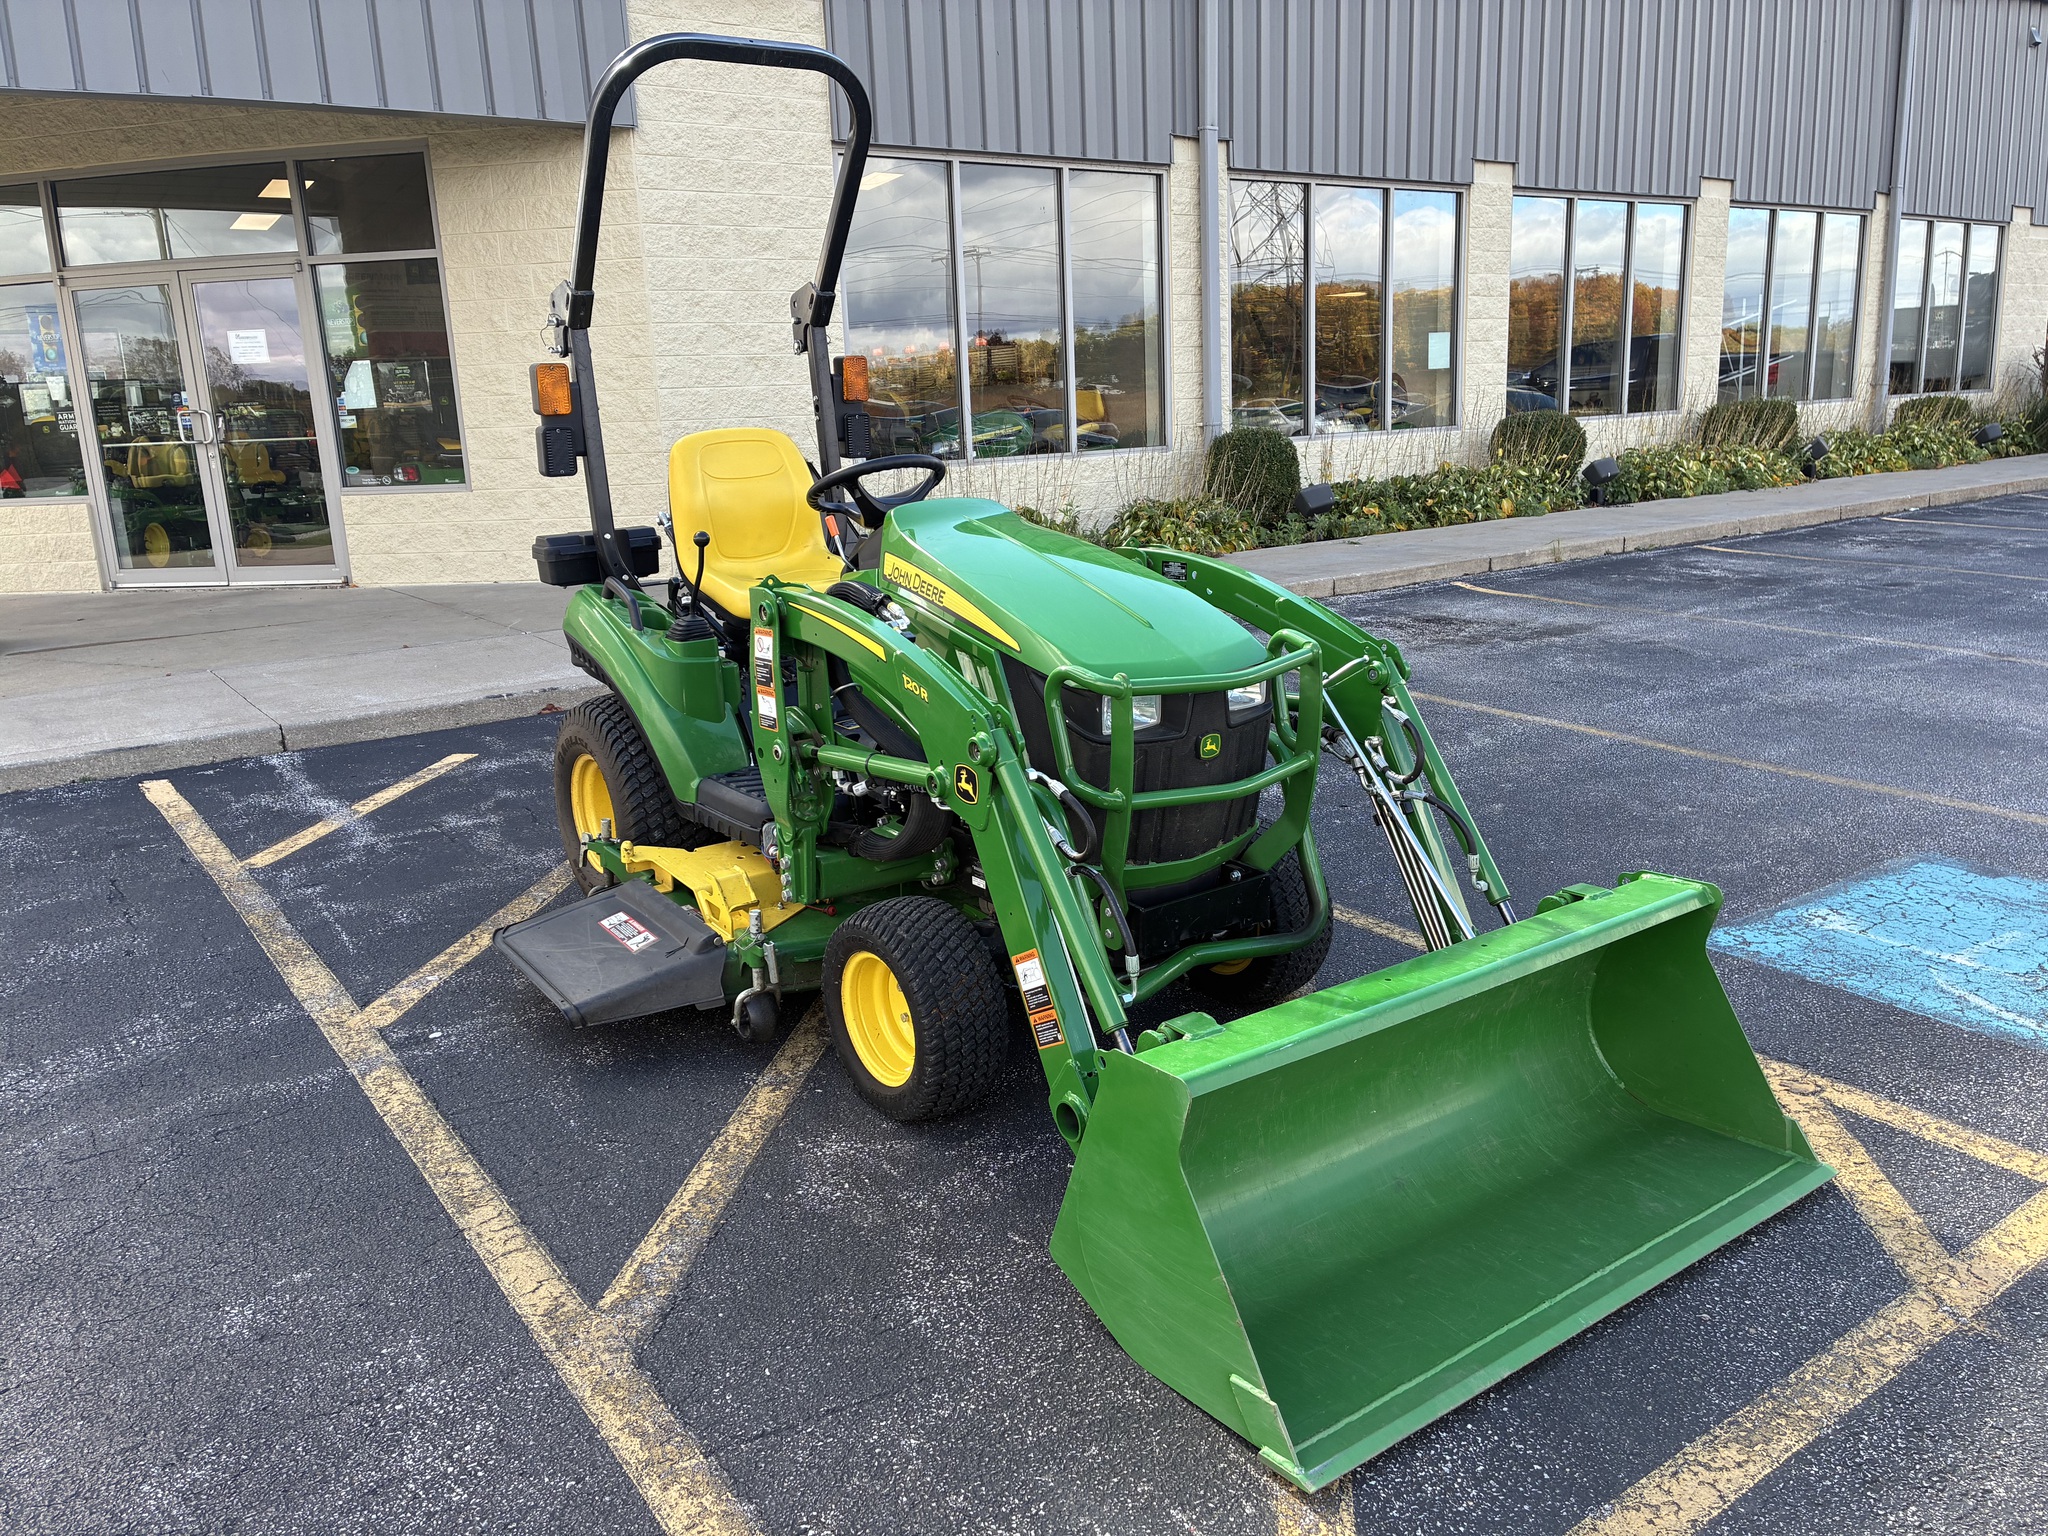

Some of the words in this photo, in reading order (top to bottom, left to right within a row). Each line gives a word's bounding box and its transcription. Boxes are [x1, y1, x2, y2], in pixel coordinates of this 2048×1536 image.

[888, 562, 912, 589] JOHN
[912, 573, 946, 605] DEERE
[1019, 951, 1036, 961] WARNING
[1038, 1012, 1054, 1022] WARNING
